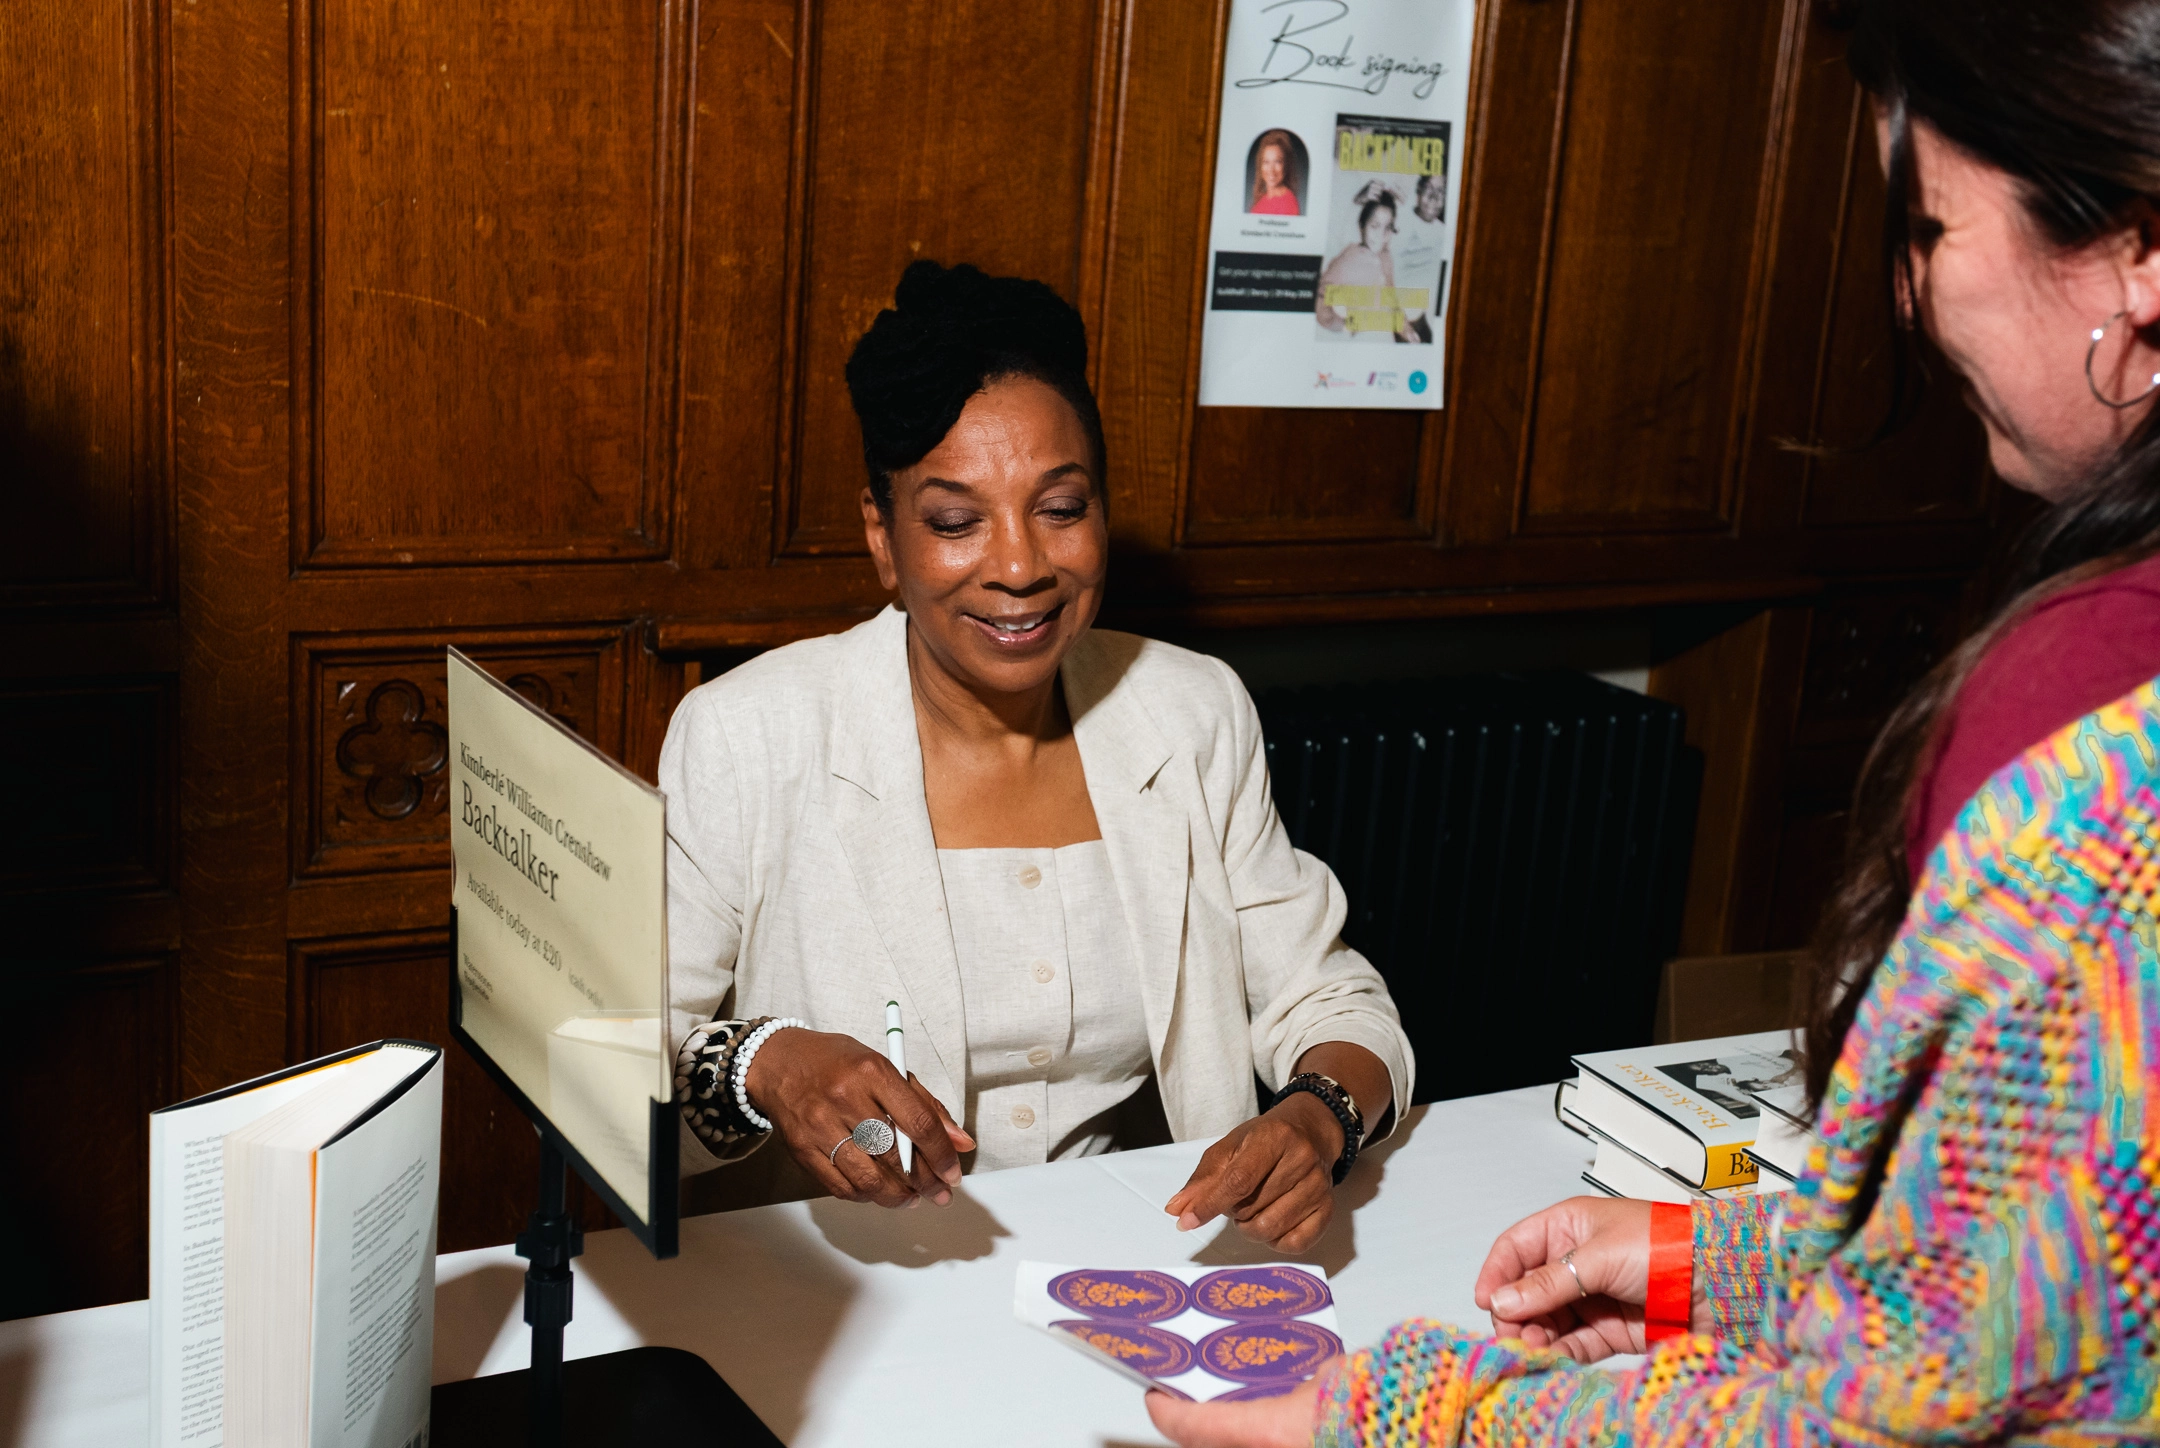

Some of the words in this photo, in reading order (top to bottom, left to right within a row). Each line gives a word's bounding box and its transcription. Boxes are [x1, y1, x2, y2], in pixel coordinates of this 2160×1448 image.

[1235, 0, 1357, 88] Book
[1362, 54, 1448, 99] signing
[1339, 131, 1444, 176] BACKTALKER
[460, 742, 505, 796] Kimberlé
[506, 777, 553, 836] Williams
[555, 819, 611, 882] Crenshaw
[462, 780, 559, 902] Backtalker
[467, 872, 504, 920] Available
[506, 909, 530, 948] today
[532, 935, 541, 955] at
[543, 940, 562, 972] £20
[1615, 1063, 1731, 1130] Backtalker
